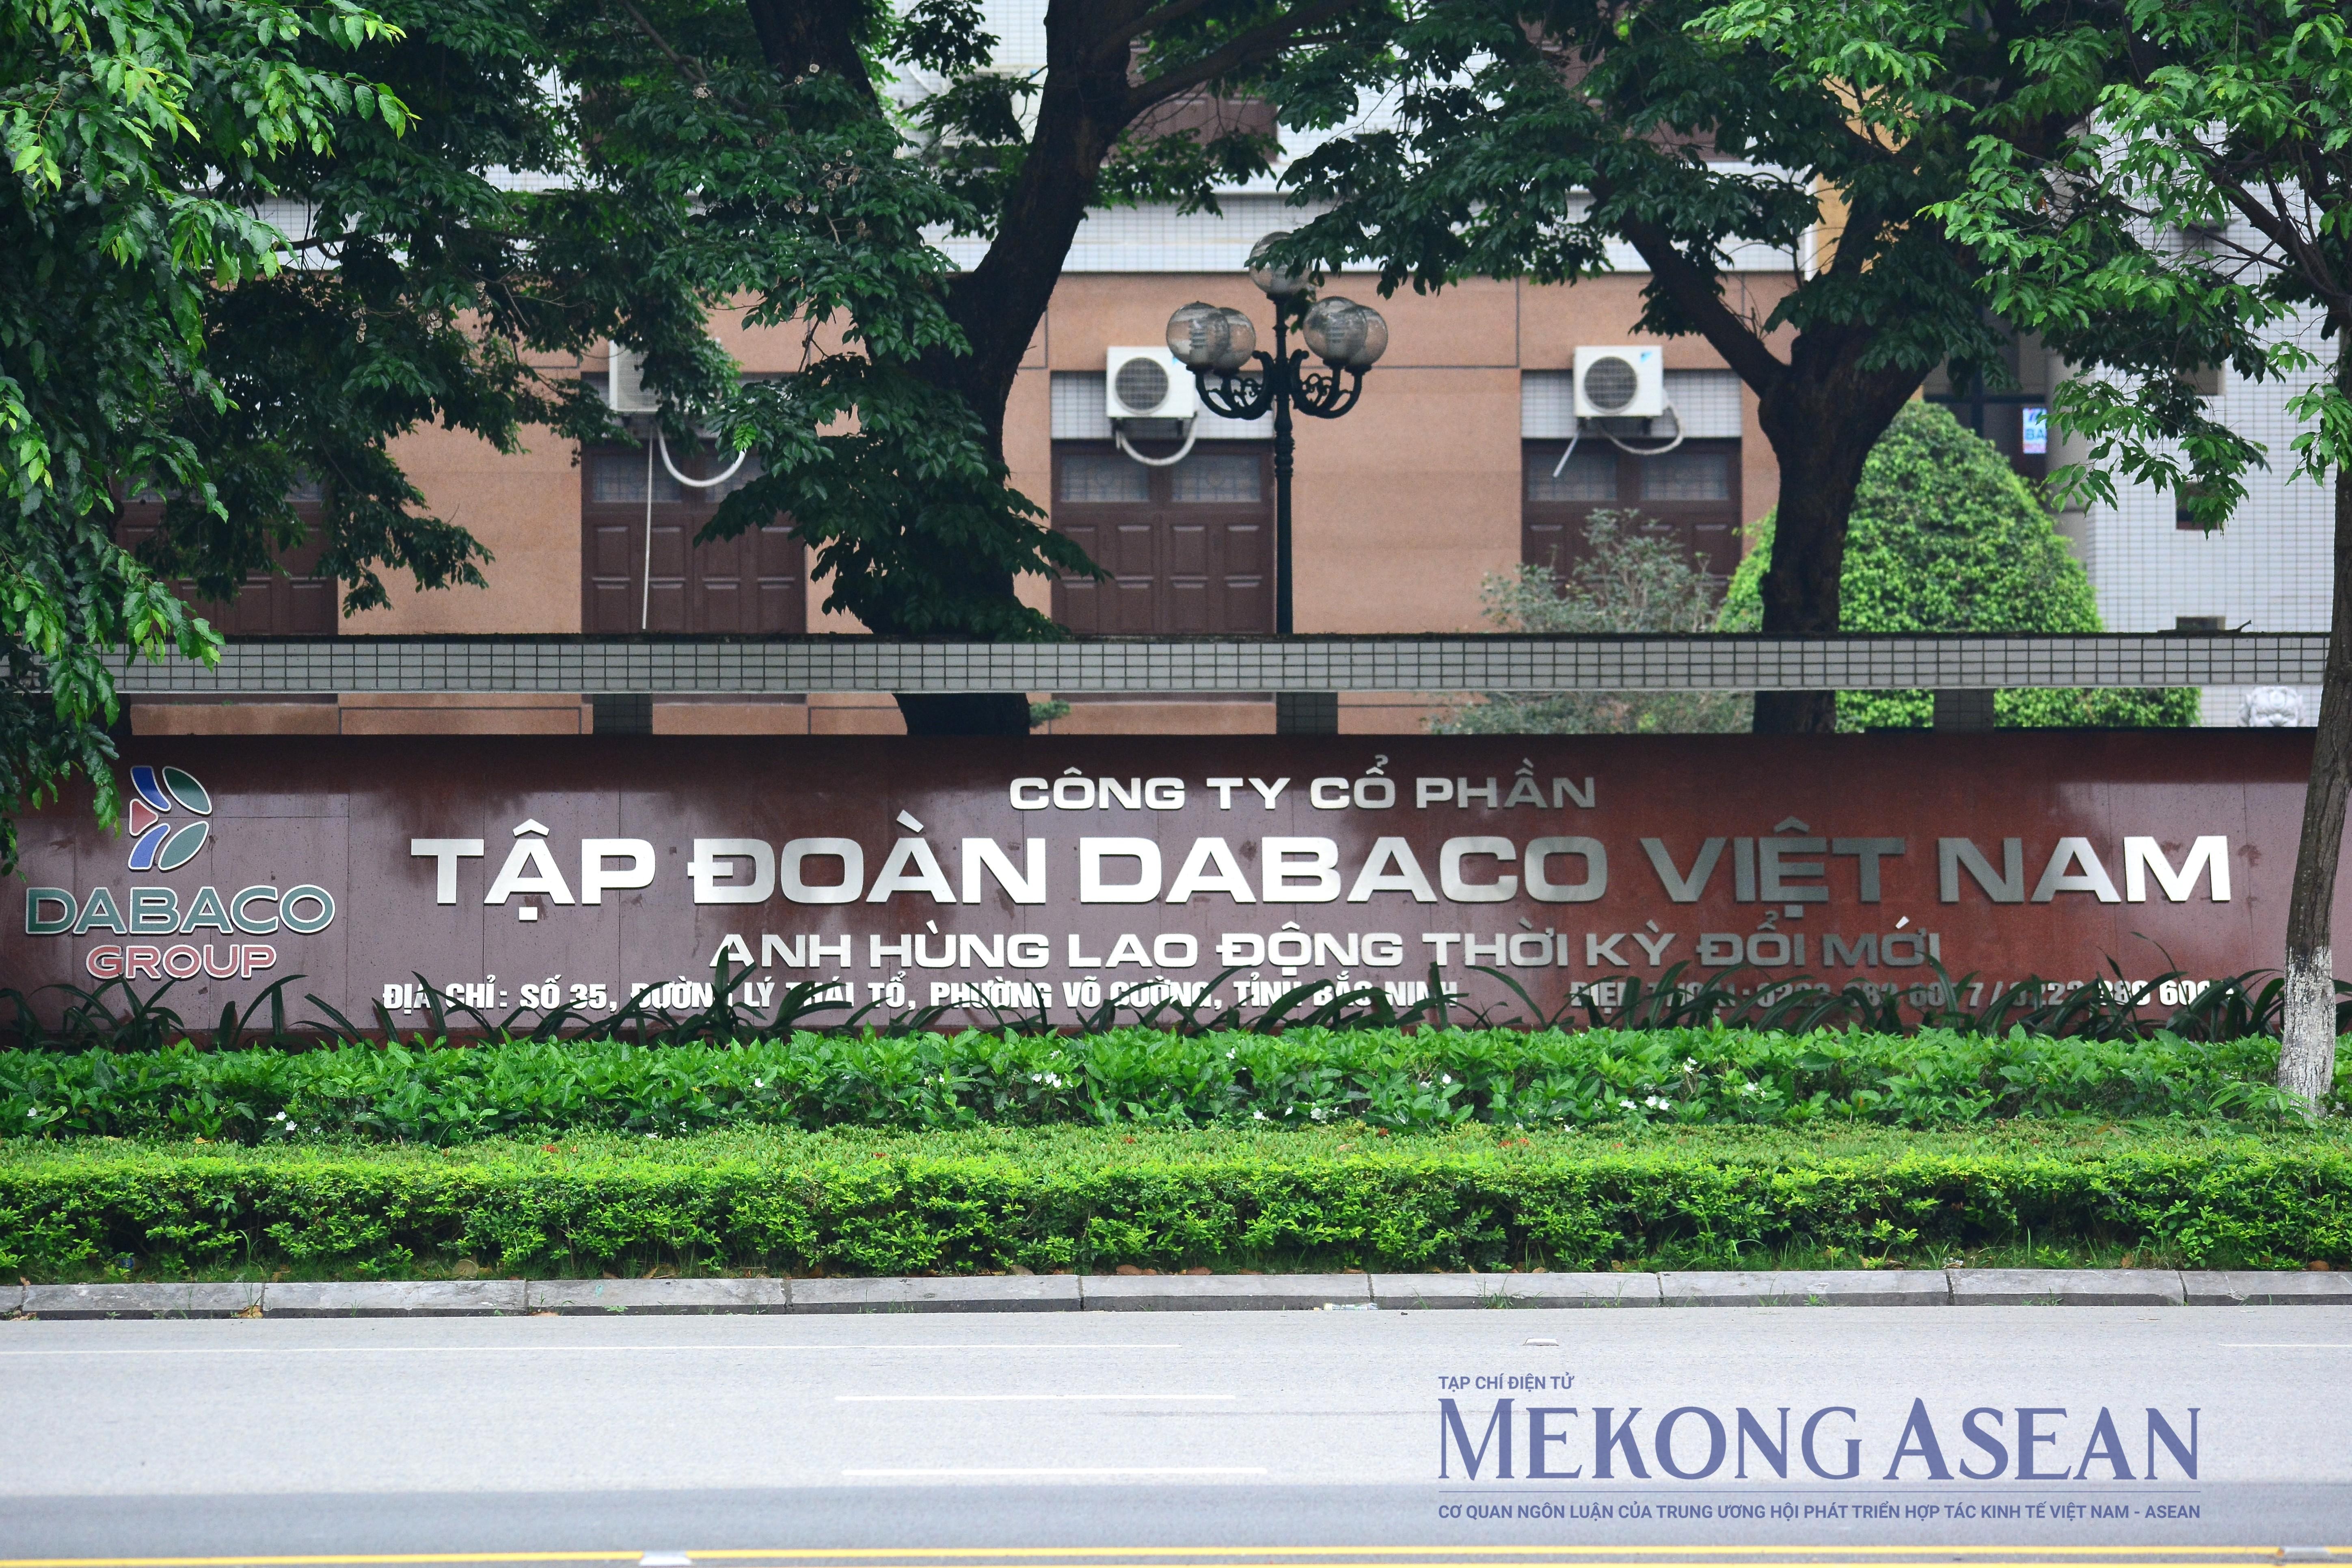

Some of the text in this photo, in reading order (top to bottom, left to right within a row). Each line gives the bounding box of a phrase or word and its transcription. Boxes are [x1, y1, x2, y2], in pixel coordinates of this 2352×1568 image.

[1010, 755, 1596, 810] CÔNG TY CỔ PHẦN
[411, 810, 2232, 921] TẬP ĐOÀN DABACO VIỆT NAM
[26, 884, 335, 934] DABACO
[86, 945, 276, 979] GROUP
[710, 910, 1941, 976] ANH HÙNG LAO ĐỘNG THỜI KỲ ĐỔI MỚI
[520, 975, 562, 1009] SỐ
[570, 984, 617, 1012] 35,
[744, 976, 775, 1007] LÝ
[868, 970, 916, 1010] TỔ,
[930, 976, 1052, 1008] PHƯỜNG
[1062, 976, 1101, 1008] VÕ
